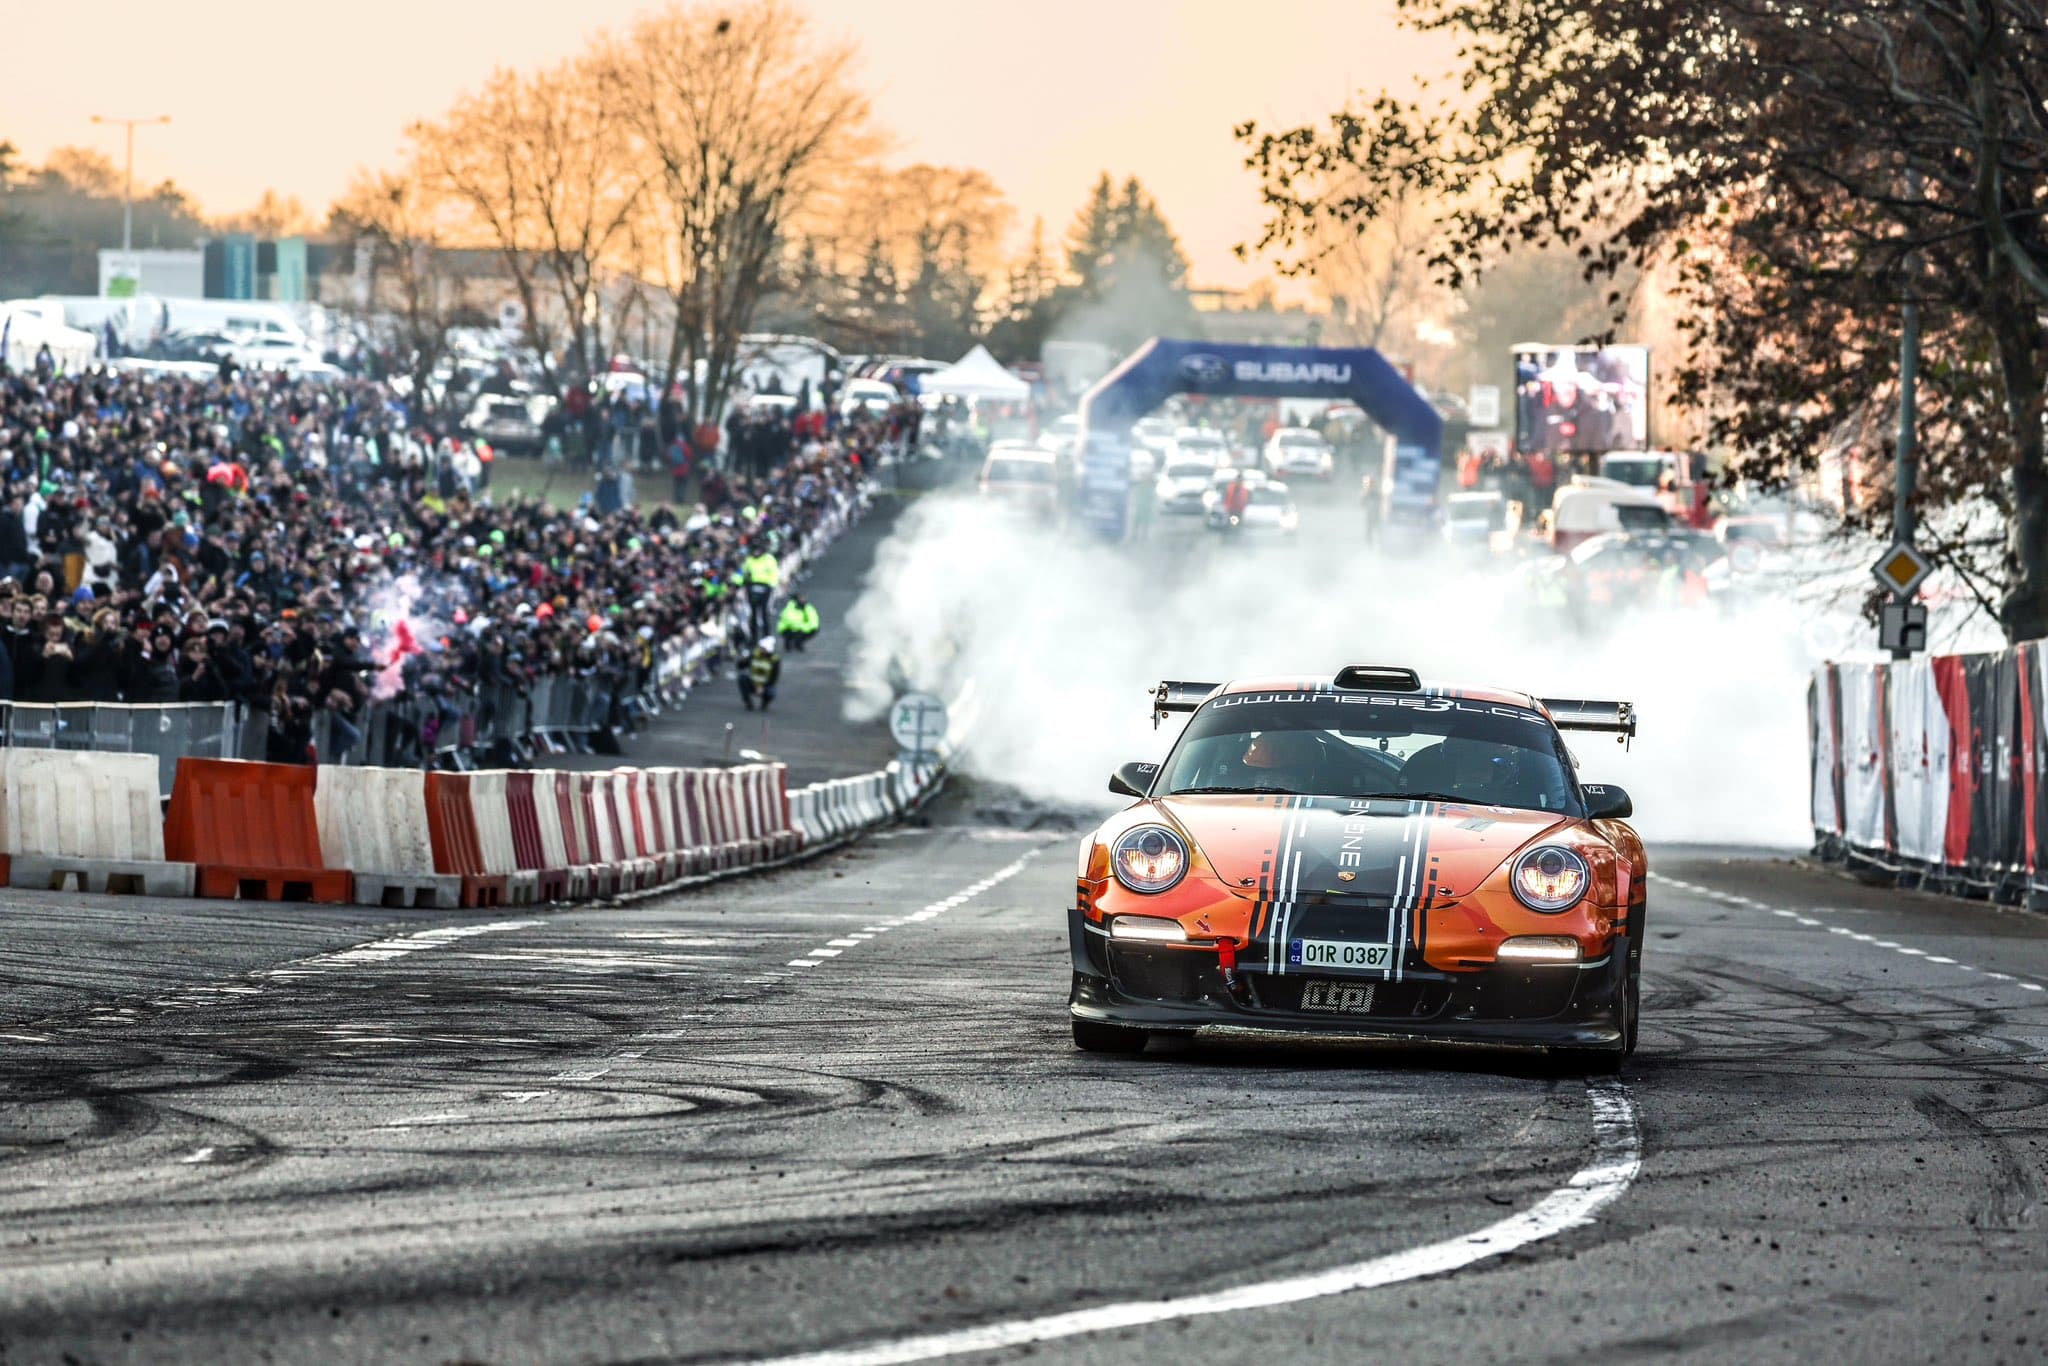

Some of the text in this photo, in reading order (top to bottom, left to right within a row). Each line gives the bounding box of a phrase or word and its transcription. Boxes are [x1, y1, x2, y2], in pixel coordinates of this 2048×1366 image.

[1234, 361, 1351, 383] SUBARU
[1306, 944, 1388, 965] 01R 0387
